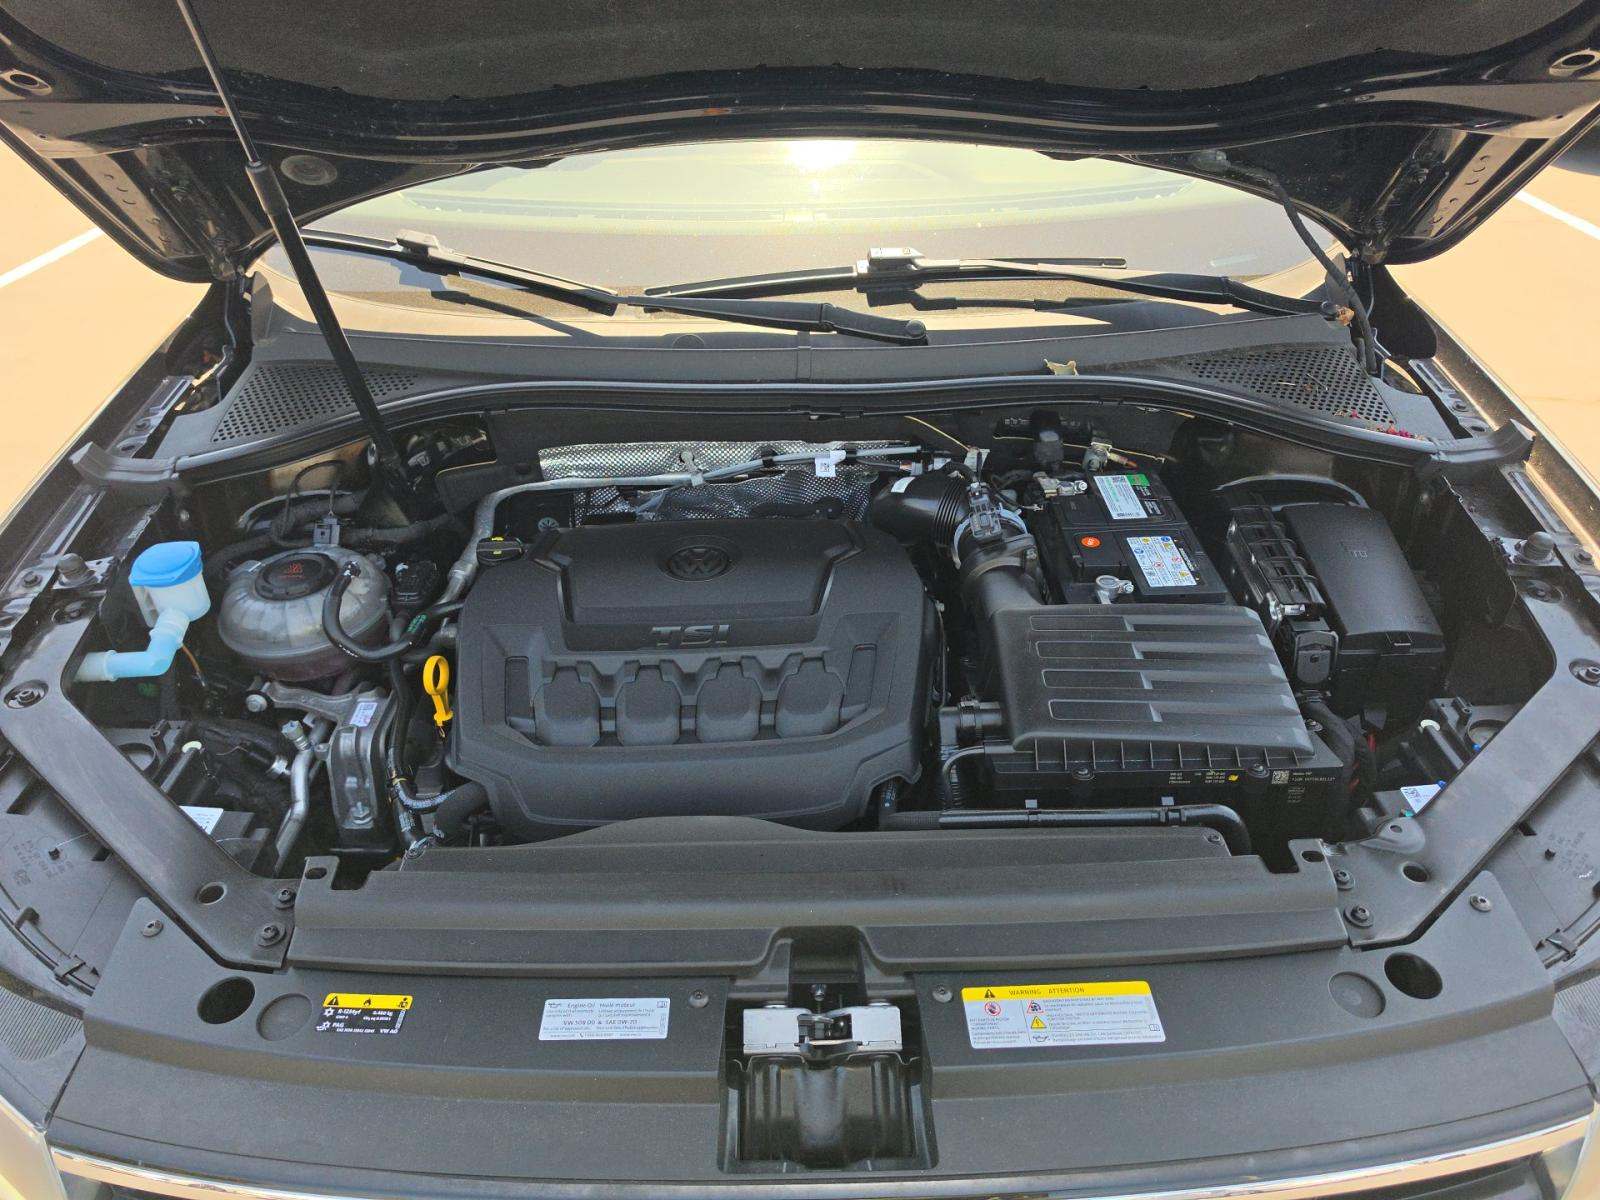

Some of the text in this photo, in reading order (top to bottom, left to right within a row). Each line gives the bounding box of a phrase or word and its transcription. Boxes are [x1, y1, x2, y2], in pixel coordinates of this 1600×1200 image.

[651, 624, 731, 647] TSI
[1008, 986, 1085, 996] WARNING ATTENTION
